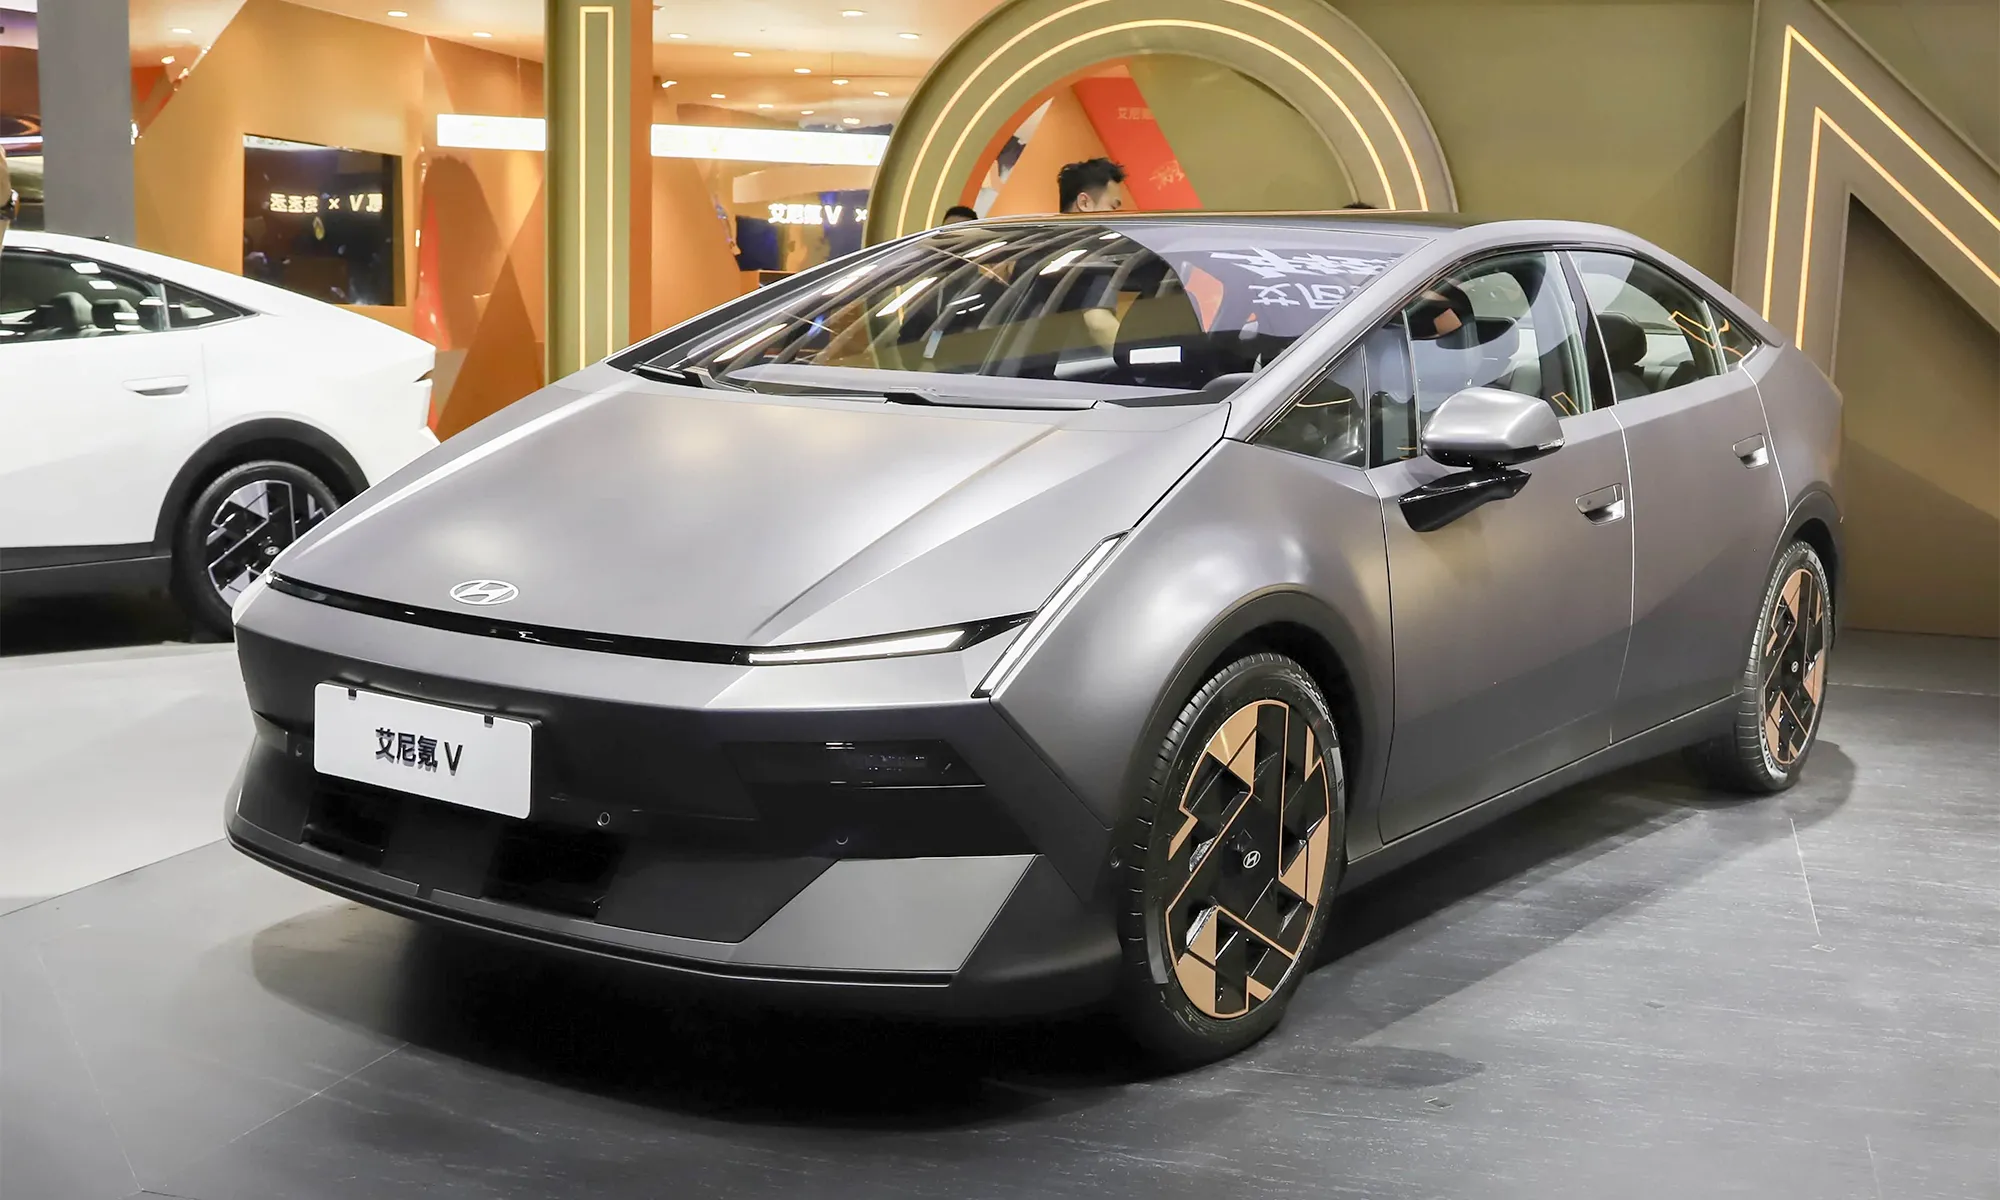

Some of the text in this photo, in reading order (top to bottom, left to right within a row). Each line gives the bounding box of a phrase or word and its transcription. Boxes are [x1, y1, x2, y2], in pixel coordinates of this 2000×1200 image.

[825, 205, 843, 225] V
[376, 727, 463, 775] 艾尼氪 V
